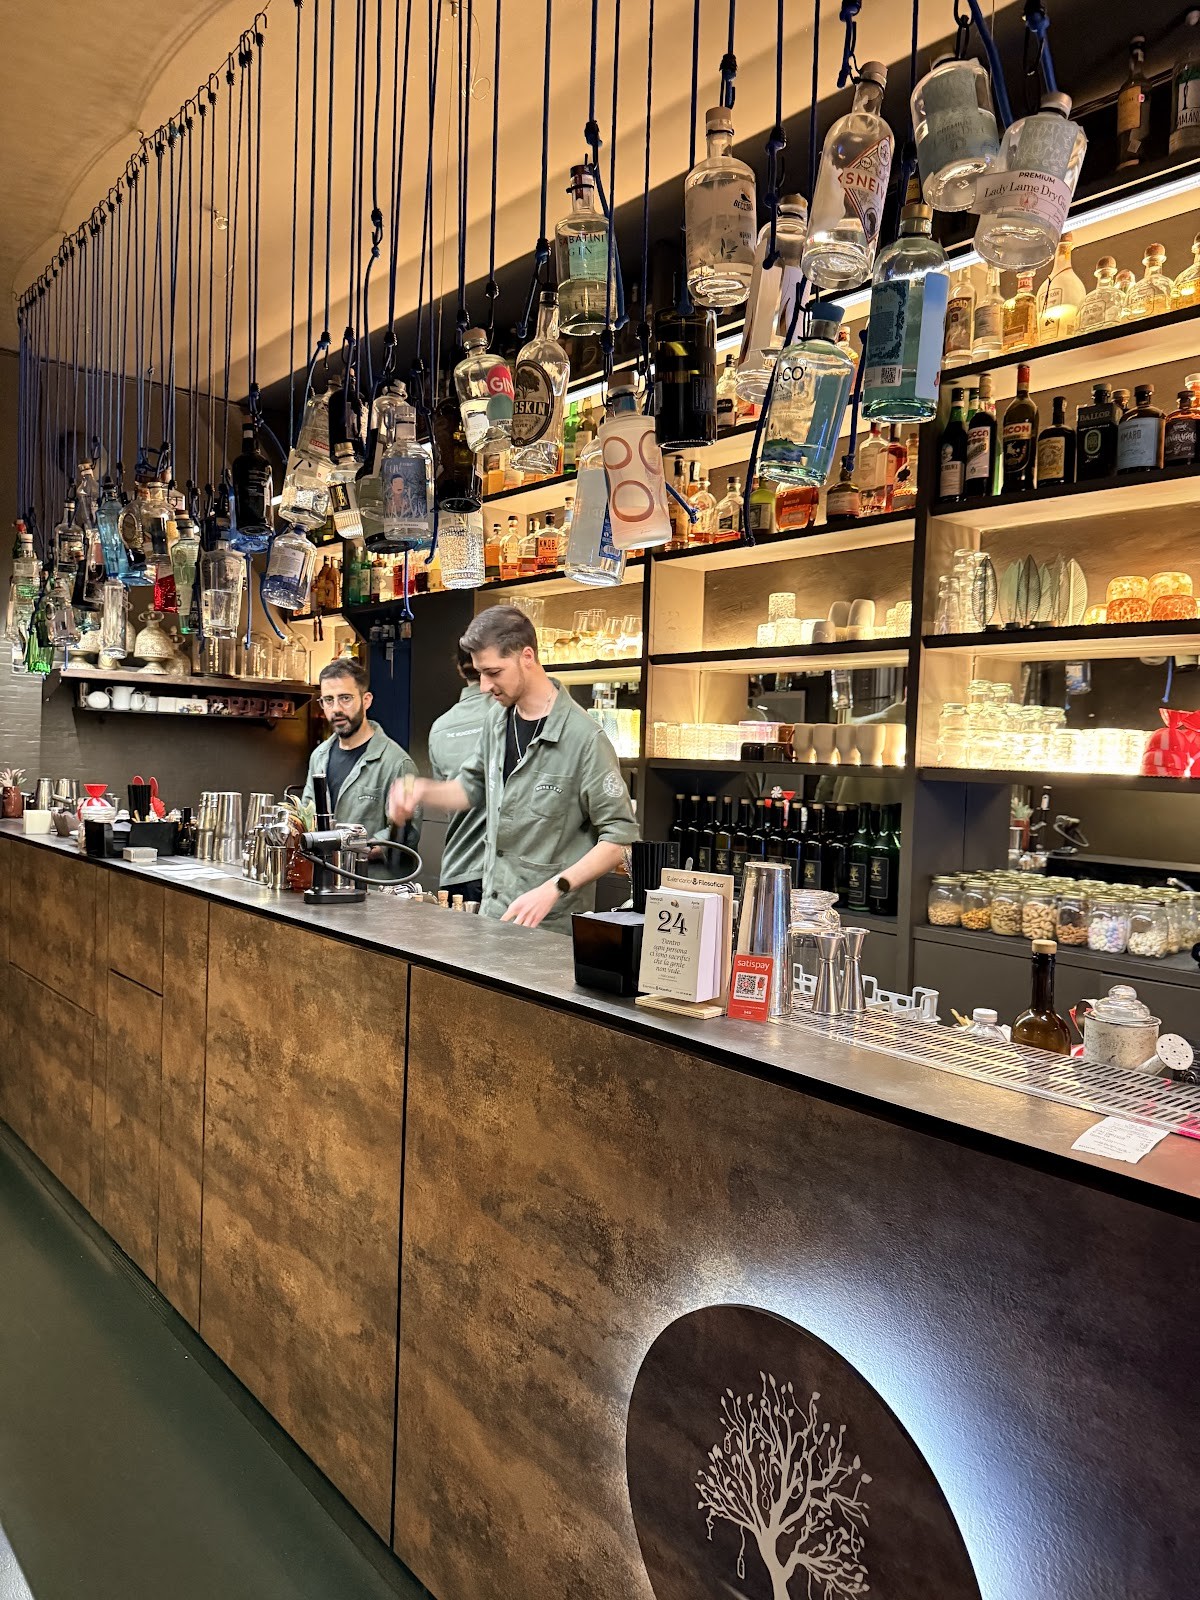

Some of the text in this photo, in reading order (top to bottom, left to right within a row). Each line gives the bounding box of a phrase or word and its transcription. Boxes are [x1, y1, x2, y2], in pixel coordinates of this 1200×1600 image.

[1019, 171, 1056, 184] PREMIUM
[984, 182, 1010, 198] Lady
[1009, 181, 1040, 194] Lame
[1040, 185, 1059, 201] Dry
[559, 233, 605, 246] SABATINI
[568, 246, 592, 256] GIN
[490, 377, 514, 392] GIN
[1079, 410, 1111, 422] BALLOR
[540, 539, 556, 547] KNOB
[657, 910, 688, 937] 24
[661, 938, 681, 947] Dentro
[653, 945, 688, 954] ogni persona
[655, 951, 668, 959] sono
[669, 961, 686, 969] gente
[737, 959, 771, 972] satispay
